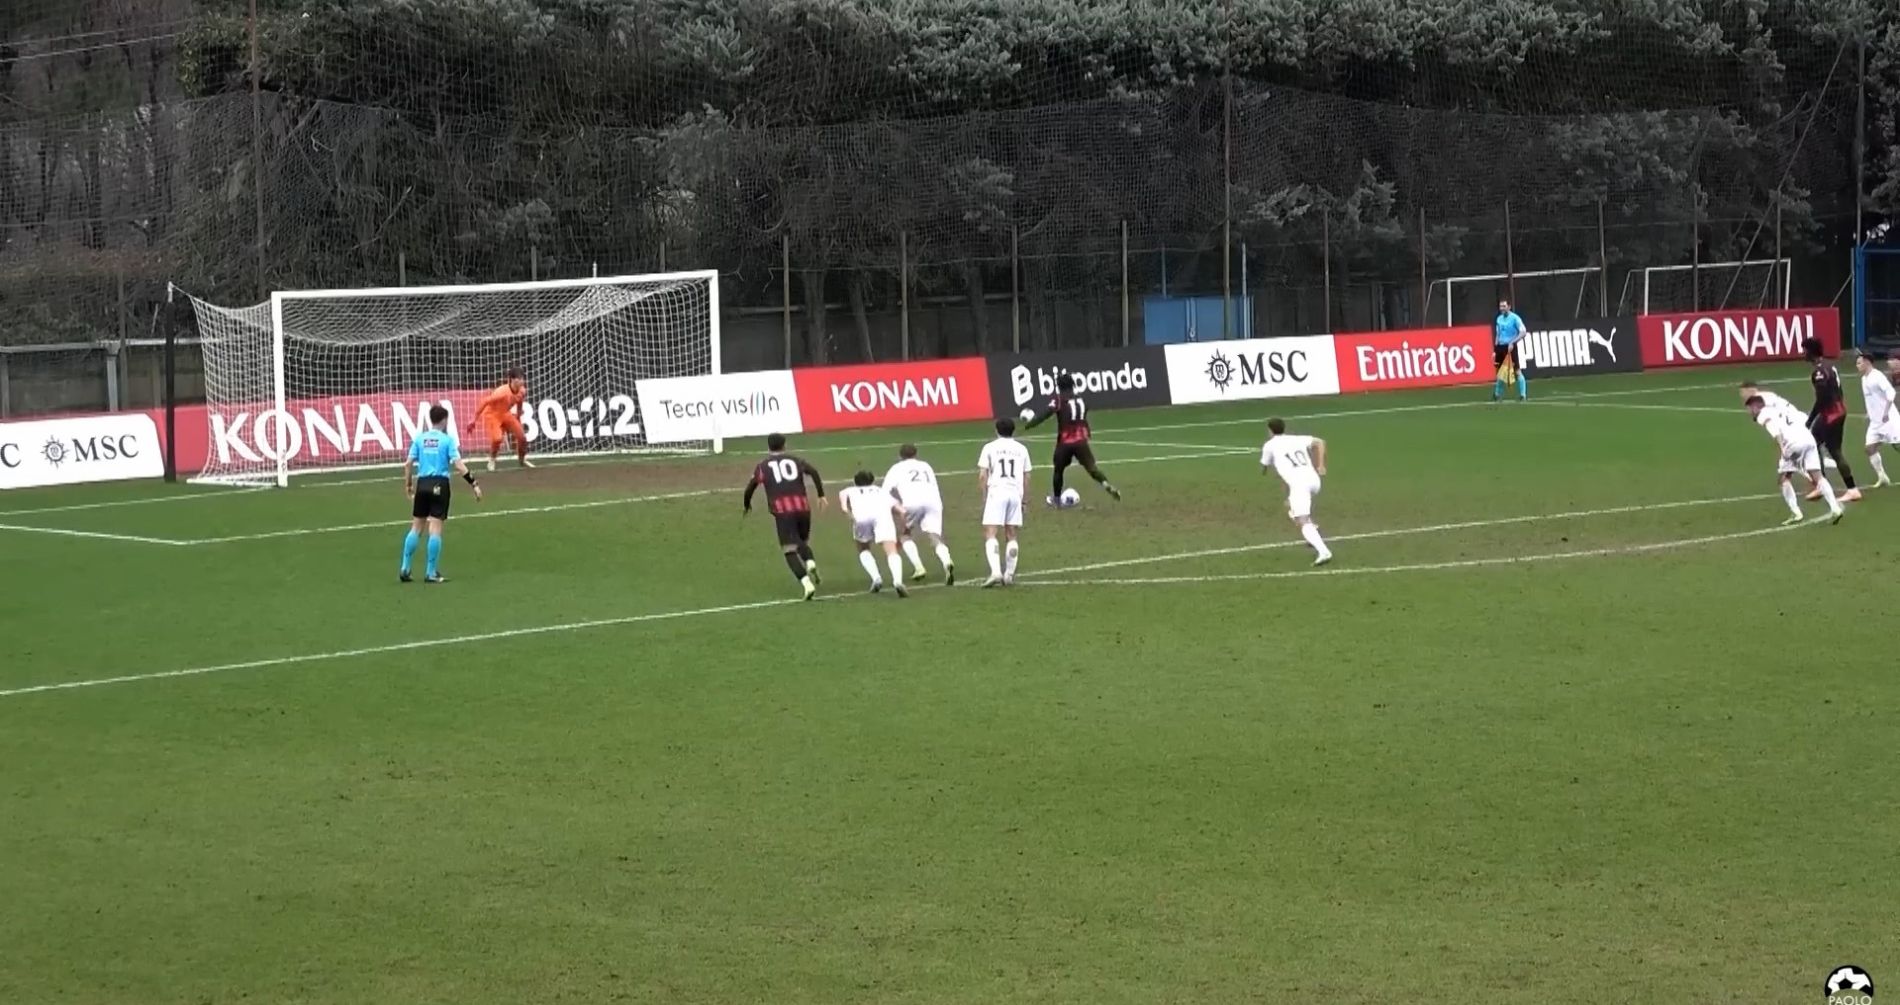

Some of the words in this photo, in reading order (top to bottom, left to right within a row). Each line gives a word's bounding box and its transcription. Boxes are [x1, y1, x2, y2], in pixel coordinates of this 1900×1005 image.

[1517, 328, 1591, 369] PUMA
[1663, 314, 1814, 361] KONAMI
[1237, 350, 1309, 385] MSC
[1356, 341, 1476, 382] Emirates
[831, 376, 959, 413] KONAMI
[1038, 362, 1147, 395] bipanda
[1068, 397, 1085, 420] 11
[0, 443, 21, 468] C
[71, 434, 139, 462] MSC
[1285, 450, 1307, 467] 10
[768, 458, 798, 483] 10
[909, 469, 931, 483] 21
[998, 458, 1016, 479] 11
